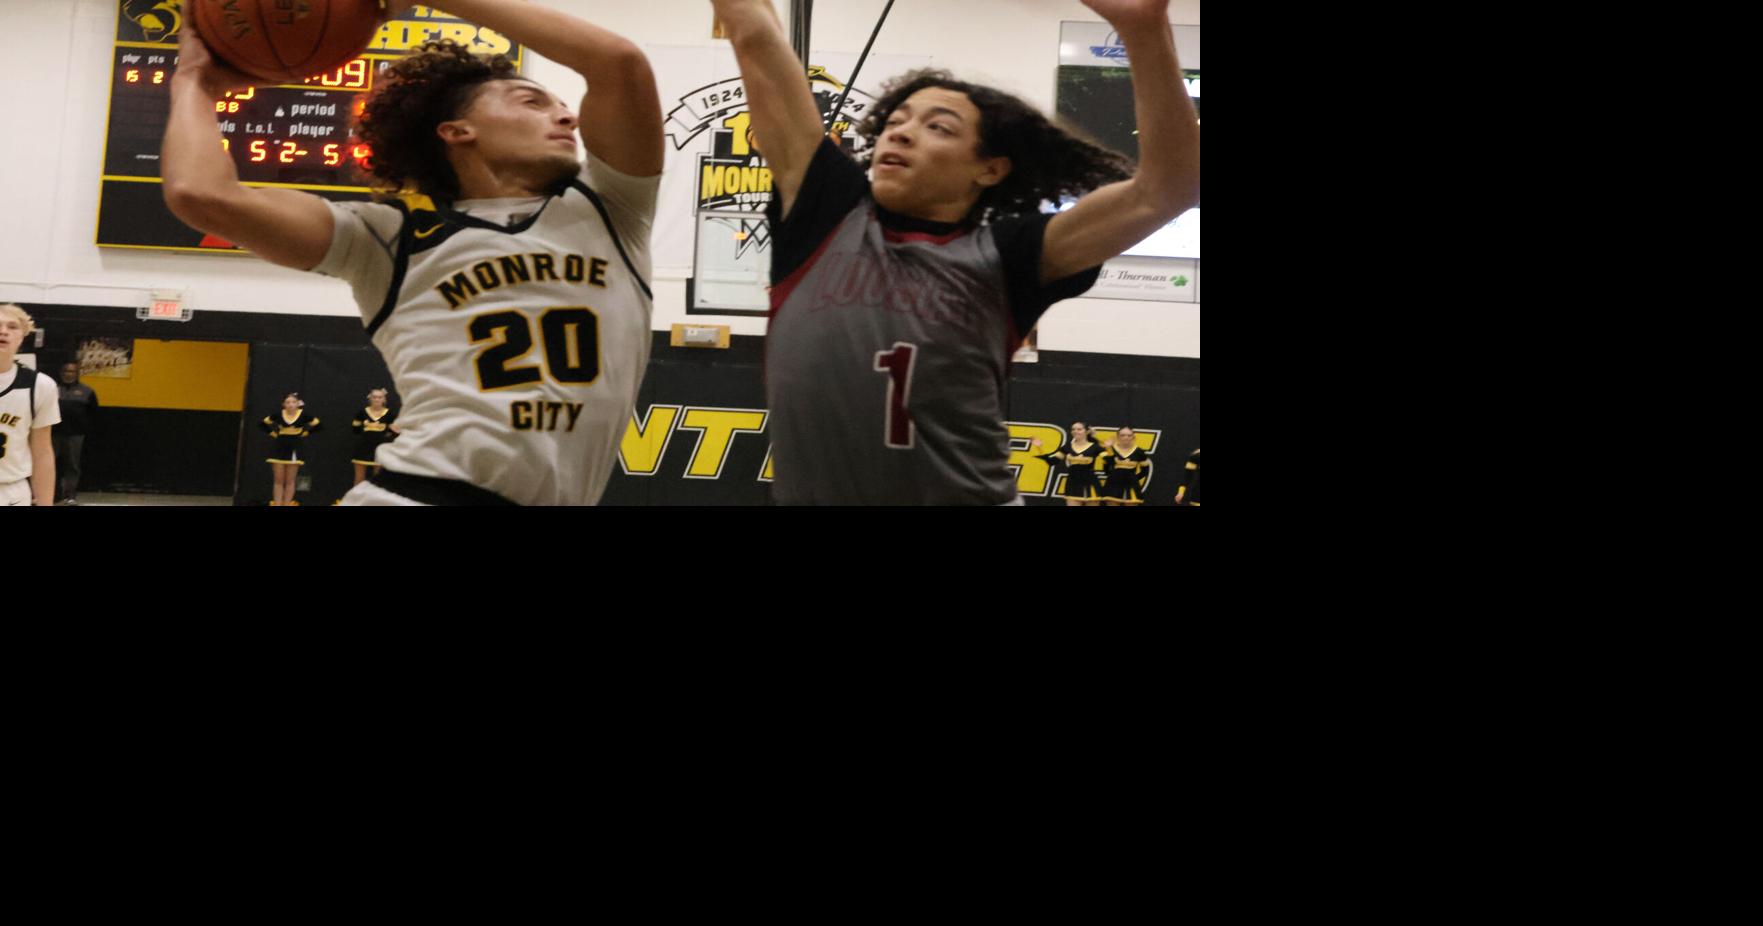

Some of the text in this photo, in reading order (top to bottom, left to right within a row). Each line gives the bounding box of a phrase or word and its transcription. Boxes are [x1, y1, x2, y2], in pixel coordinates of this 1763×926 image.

[153, 71, 164, 84] 2
[702, 86, 743, 109] 1924
[291, 104, 336, 117] period
[289, 122, 334, 138] player
[249, 140, 266, 162] 5
[323, 144, 339, 165] 5
[733, 192, 773, 204] TOUR
[435, 253, 608, 310] MONROE
[1118, 270, 1167, 282] Thurman
[154, 302, 177, 316] EXIT
[466, 307, 600, 392] 20
[873, 341, 918, 449] 1
[511, 400, 583, 432] CITY
